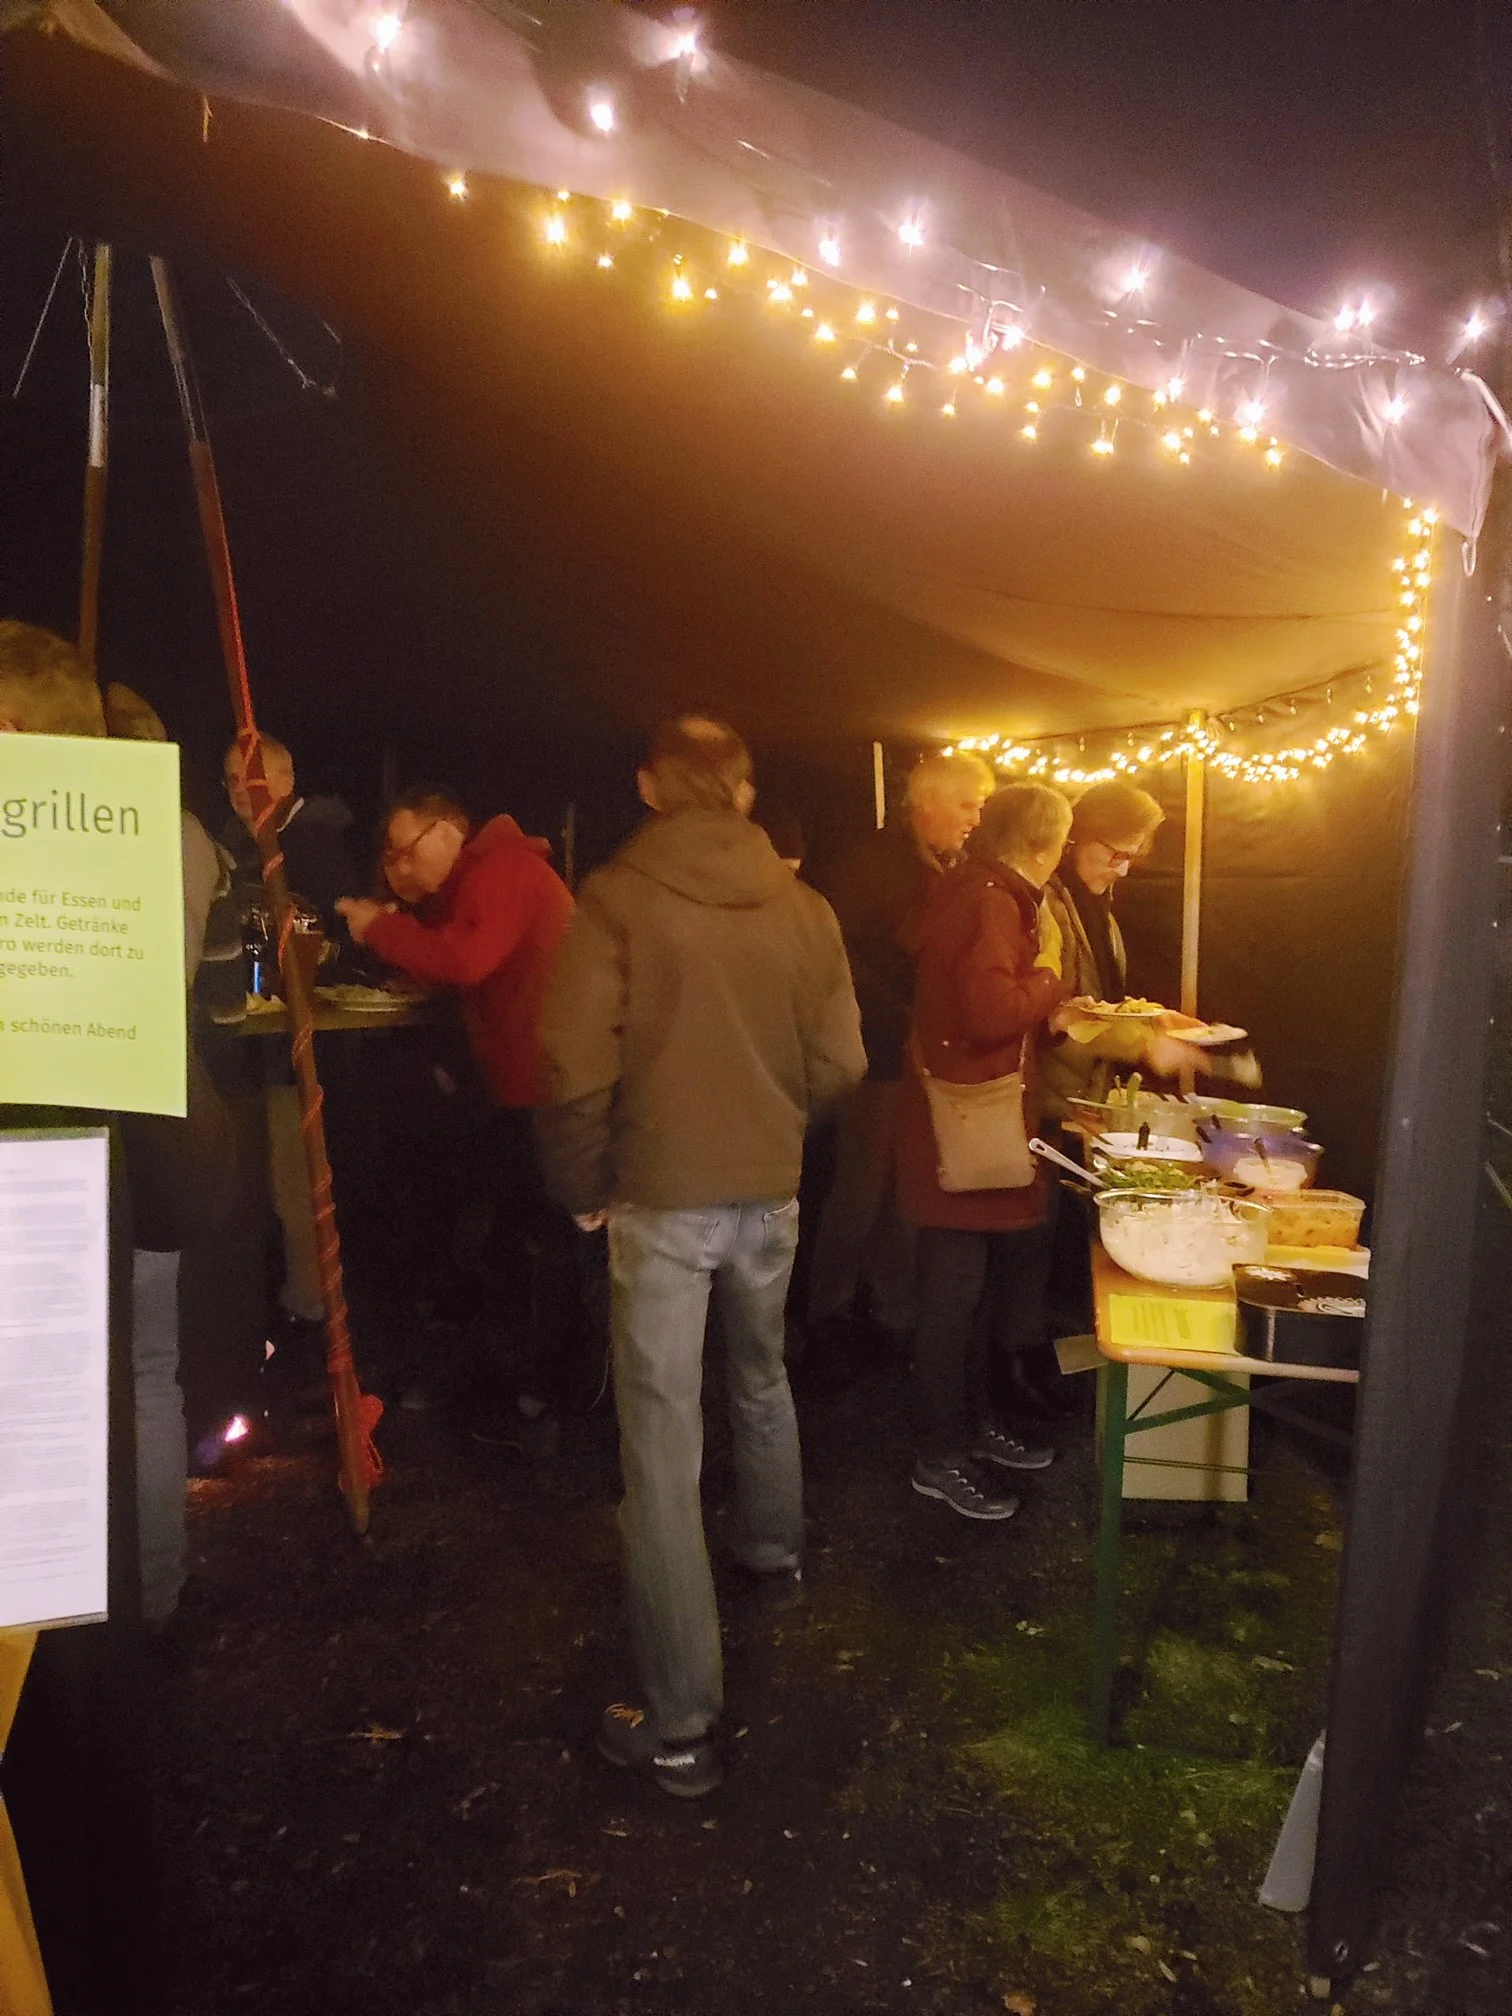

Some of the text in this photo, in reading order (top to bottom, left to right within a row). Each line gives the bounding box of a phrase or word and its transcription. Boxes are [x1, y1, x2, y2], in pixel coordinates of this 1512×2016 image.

[2, 790, 139, 838] grillen
[31, 888, 57, 905] für
[62, 891, 107, 908] Essen
[111, 896, 141, 911] und
[56, 914, 129, 934] Getränke
[22, 937, 84, 955] werden
[89, 941, 123, 958] dort
[126, 946, 144, 960] zu
[11, 1017, 82, 1036] schönen
[86, 1022, 137, 1040] Abend
